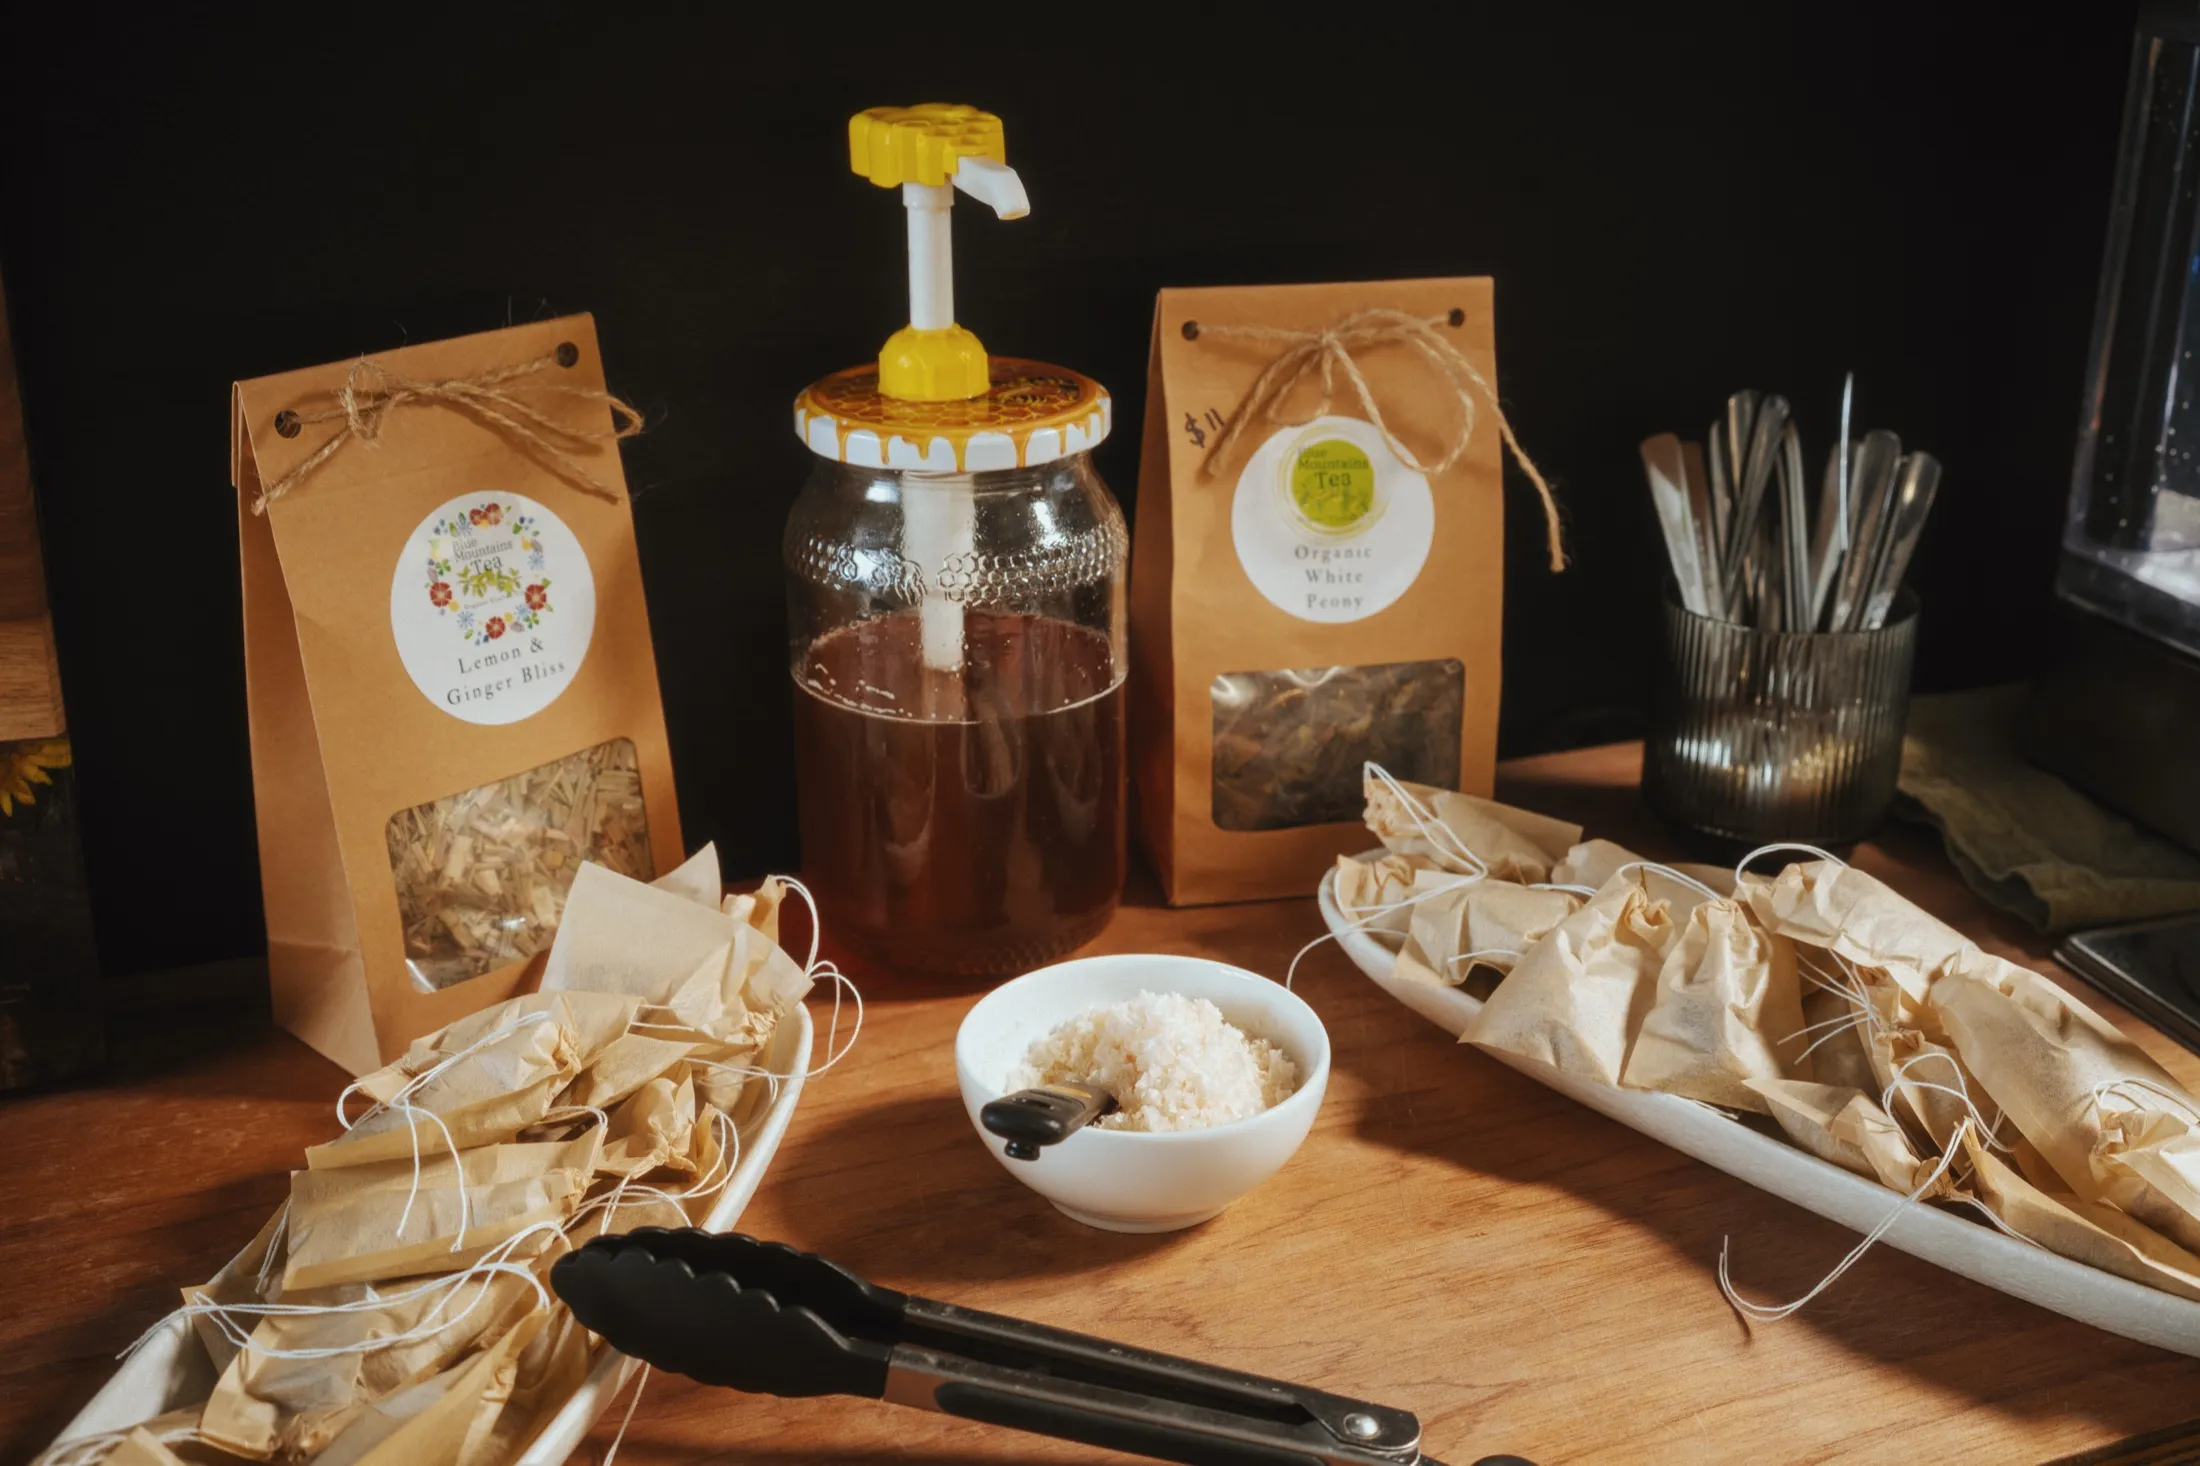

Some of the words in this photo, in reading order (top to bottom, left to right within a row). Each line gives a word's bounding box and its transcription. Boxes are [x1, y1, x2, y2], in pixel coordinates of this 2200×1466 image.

[1313, 471, 1352, 490] Tea
[454, 541, 513, 562] Mountains
[1294, 545, 1372, 565] Organic
[470, 556, 503, 576] Tea
[1304, 569, 1364, 585] White
[1306, 593, 1364, 611] Peony
[458, 648, 521, 675] Lemon
[530, 637, 544, 654] &
[446, 676, 513, 706] Ginger
[521, 661, 565, 684] Bliss
